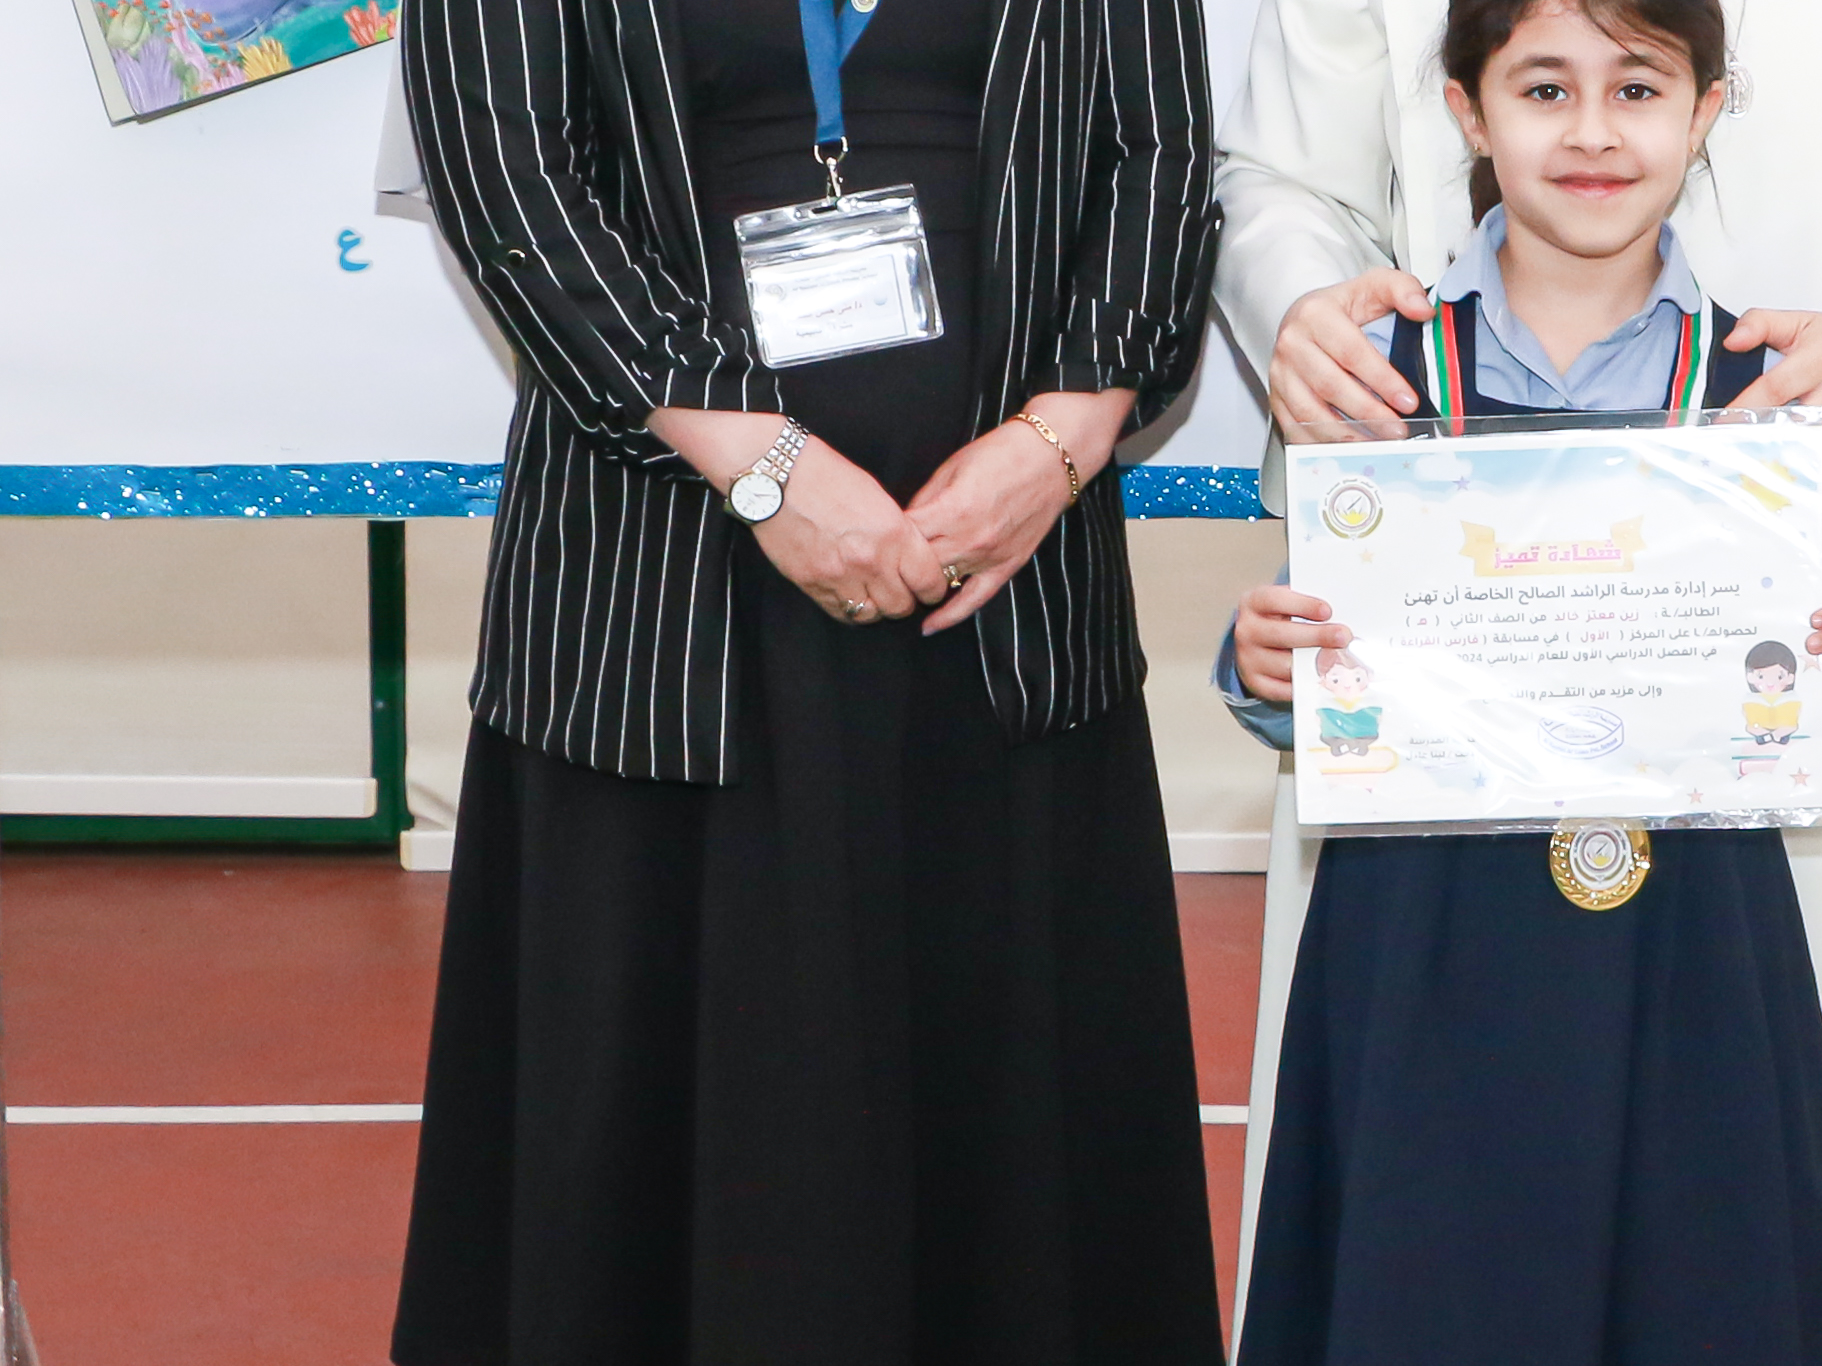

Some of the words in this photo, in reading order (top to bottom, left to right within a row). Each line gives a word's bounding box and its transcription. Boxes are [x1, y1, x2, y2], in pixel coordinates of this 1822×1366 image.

[337, 228, 369, 272] ع
[1494, 545, 1541, 569] تميز
[1443, 584, 1459, 605] أن
[1464, 587, 1514, 601] الخاصة
[1518, 585, 1565, 606] الصالح
[1571, 583, 1615, 600] الراشد
[1620, 582, 1670, 599] مدرسة
[1674, 580, 1706, 598] إدارة
[1710, 583, 1740, 597] يسر
[1404, 589, 1439, 607] تهنئ
[1488, 612, 1525, 624] الصف
[1529, 613, 1547, 625] من
[1554, 610, 1579, 622] خالد
[1585, 610, 1615, 623] معتز
[1619, 608, 1639, 621] زين
[1450, 613, 1483, 630] الثاني
[1493, 633, 1540, 644] مسابقة
[1543, 633, 1560, 647] في
[1580, 631, 1610, 643] الأول
[1629, 629, 1665, 642] المركز
[1669, 628, 1690, 640] على
[1444, 635, 1480, 647] فارس
[1537, 650, 1569, 663] للعام
[1572, 649, 1602, 662] الأول
[1606, 648, 1653, 664] الدراسي
[1657, 647, 1697, 659] الفصل
[1701, 648, 1718, 661] في
[1487, 652, 1534, 668] الدراسي
[1589, 688, 1606, 699] من
[1610, 687, 1634, 699] مزيد
[1639, 685, 1663, 699] وإلى
